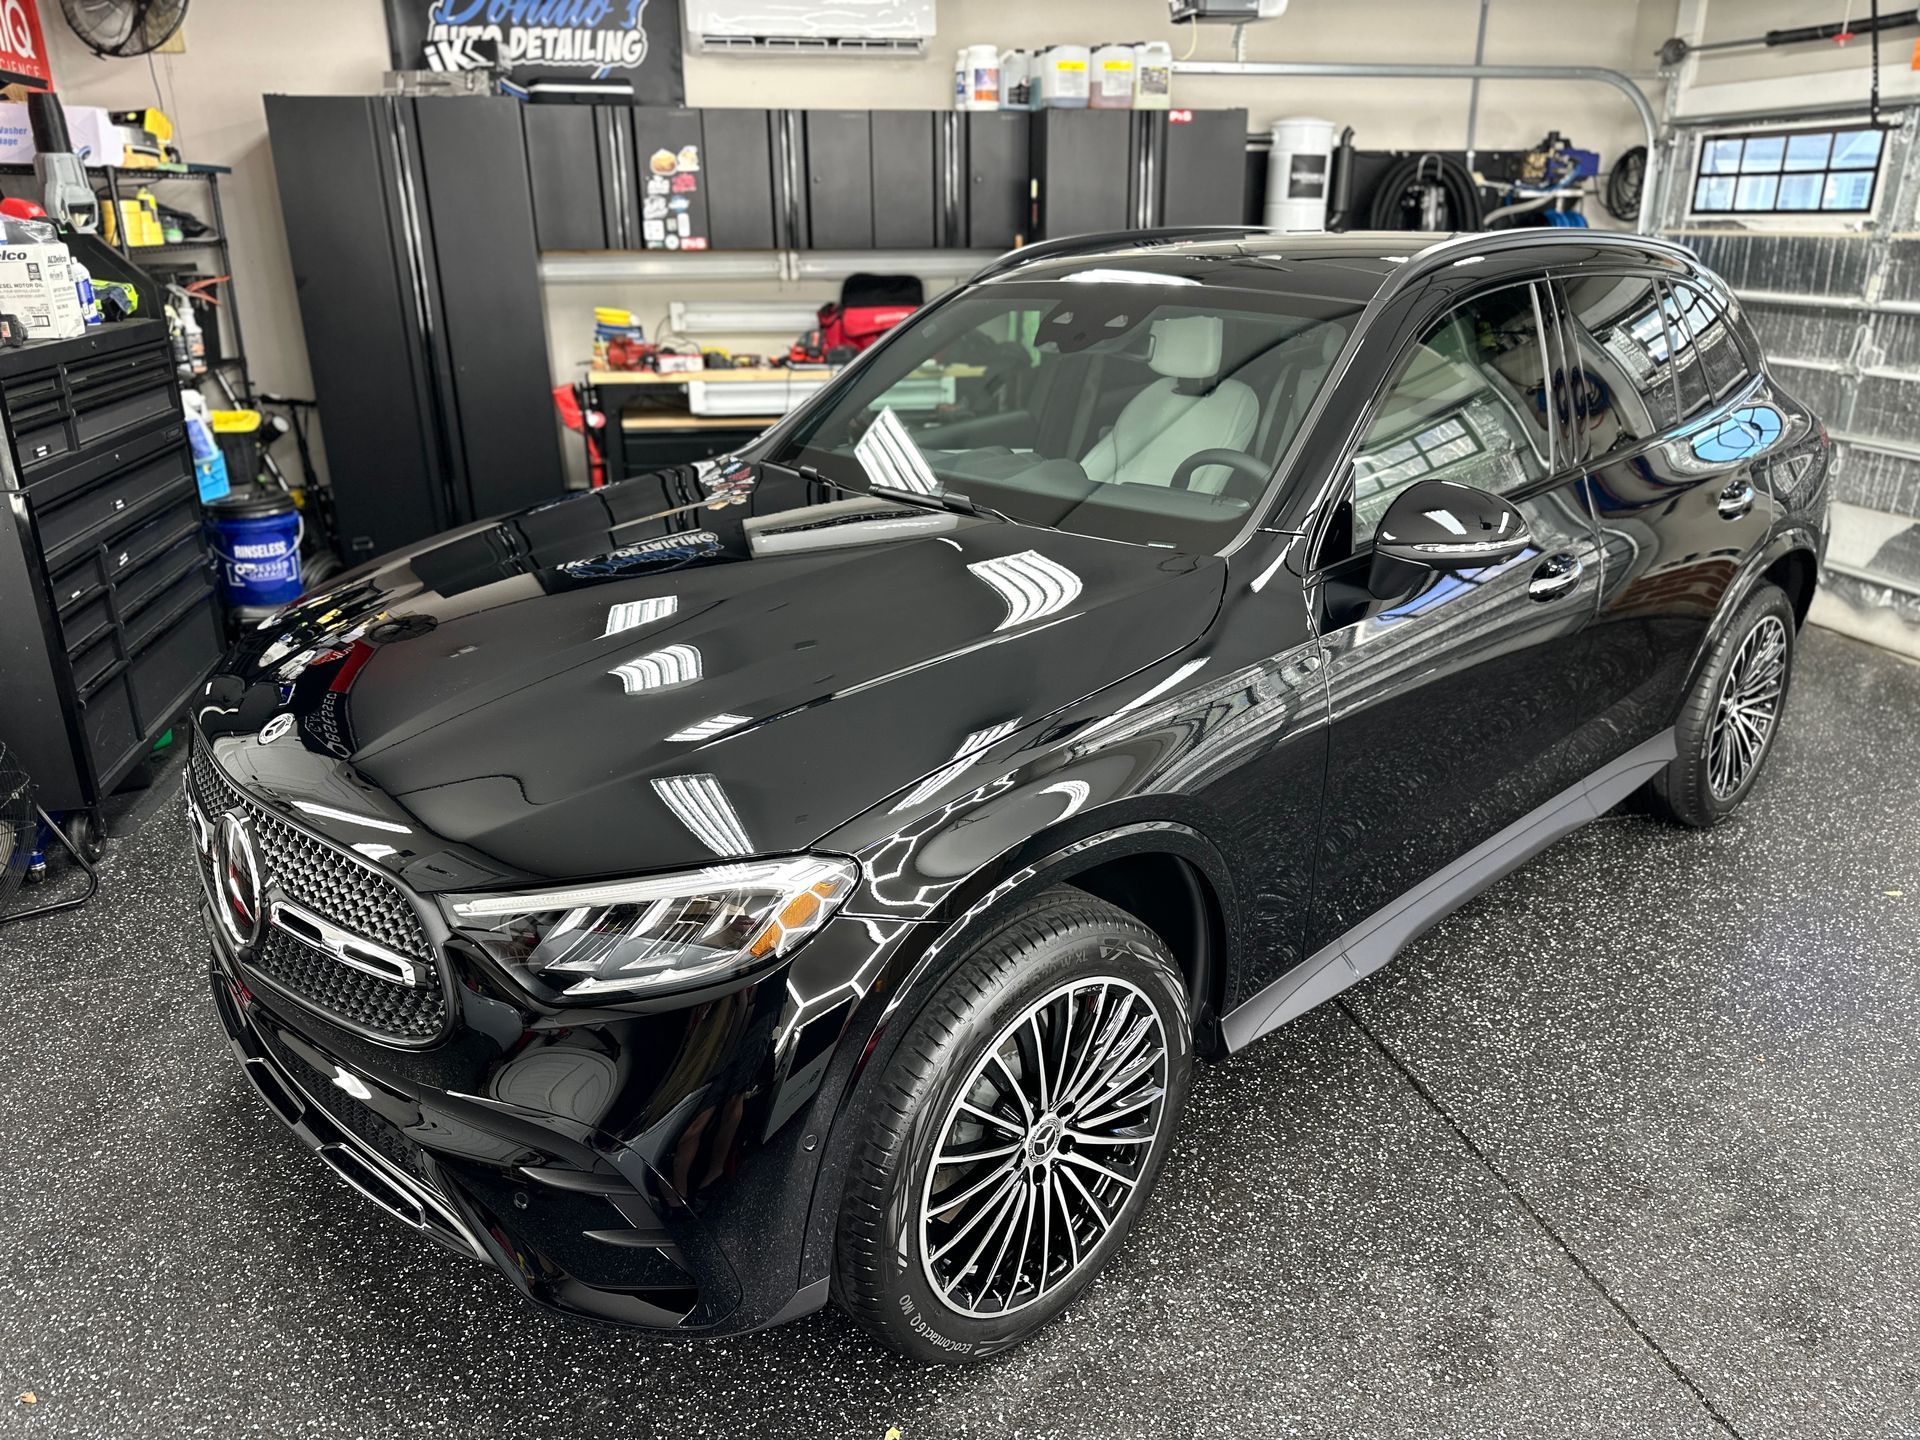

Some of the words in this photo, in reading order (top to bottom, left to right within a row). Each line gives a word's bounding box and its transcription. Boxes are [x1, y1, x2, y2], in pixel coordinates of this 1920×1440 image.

[510, 26, 643, 63] DETAILING
[0, 250, 27, 261] lco
[233, 541, 287, 559] RINSELESS
[899, 1294, 916, 1316] MO
[921, 1326, 973, 1354] EcoContact
